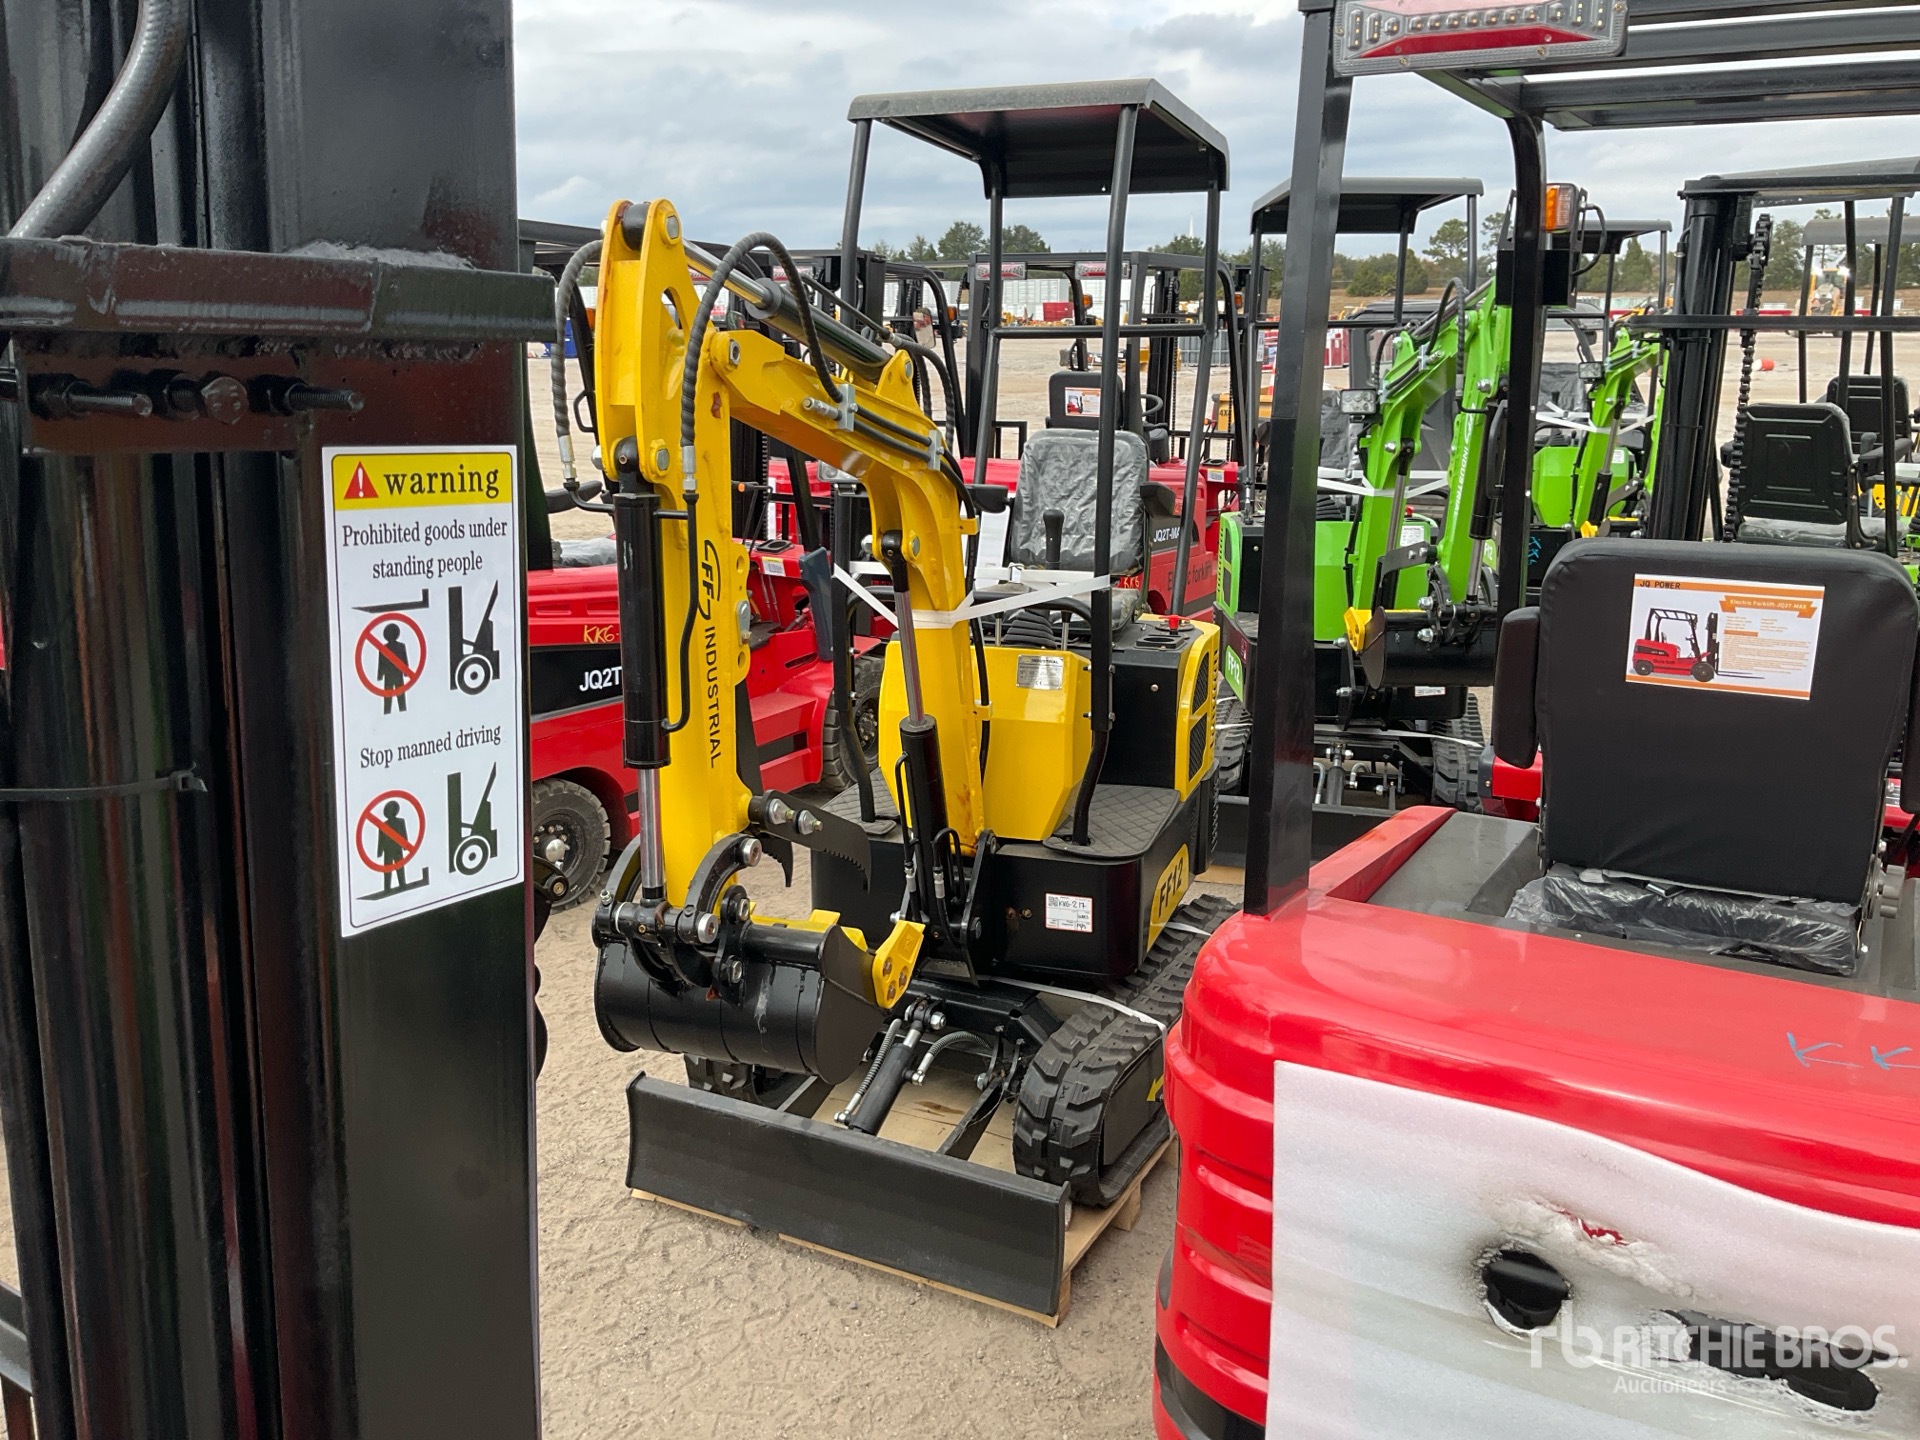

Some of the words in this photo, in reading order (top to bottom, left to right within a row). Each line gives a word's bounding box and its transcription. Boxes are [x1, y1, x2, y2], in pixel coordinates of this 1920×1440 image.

[384, 464, 499, 498] warning
[1454, 446, 1469, 517] INDUSTRIAL
[342, 521, 421, 547] Prohibited
[425, 519, 465, 546] goods
[469, 517, 507, 539] under
[372, 555, 434, 579] standing
[438, 550, 483, 578] people
[1640, 580, 1650, 588] JQ
[1655, 581, 1681, 590] POWER
[1228, 651, 1240, 685] FF12
[705, 626, 721, 768] INDUSTRIAL
[360, 747, 393, 768] Stop
[397, 731, 451, 761] manned
[456, 725, 501, 749] driving
[1158, 857, 1183, 918] FF12
